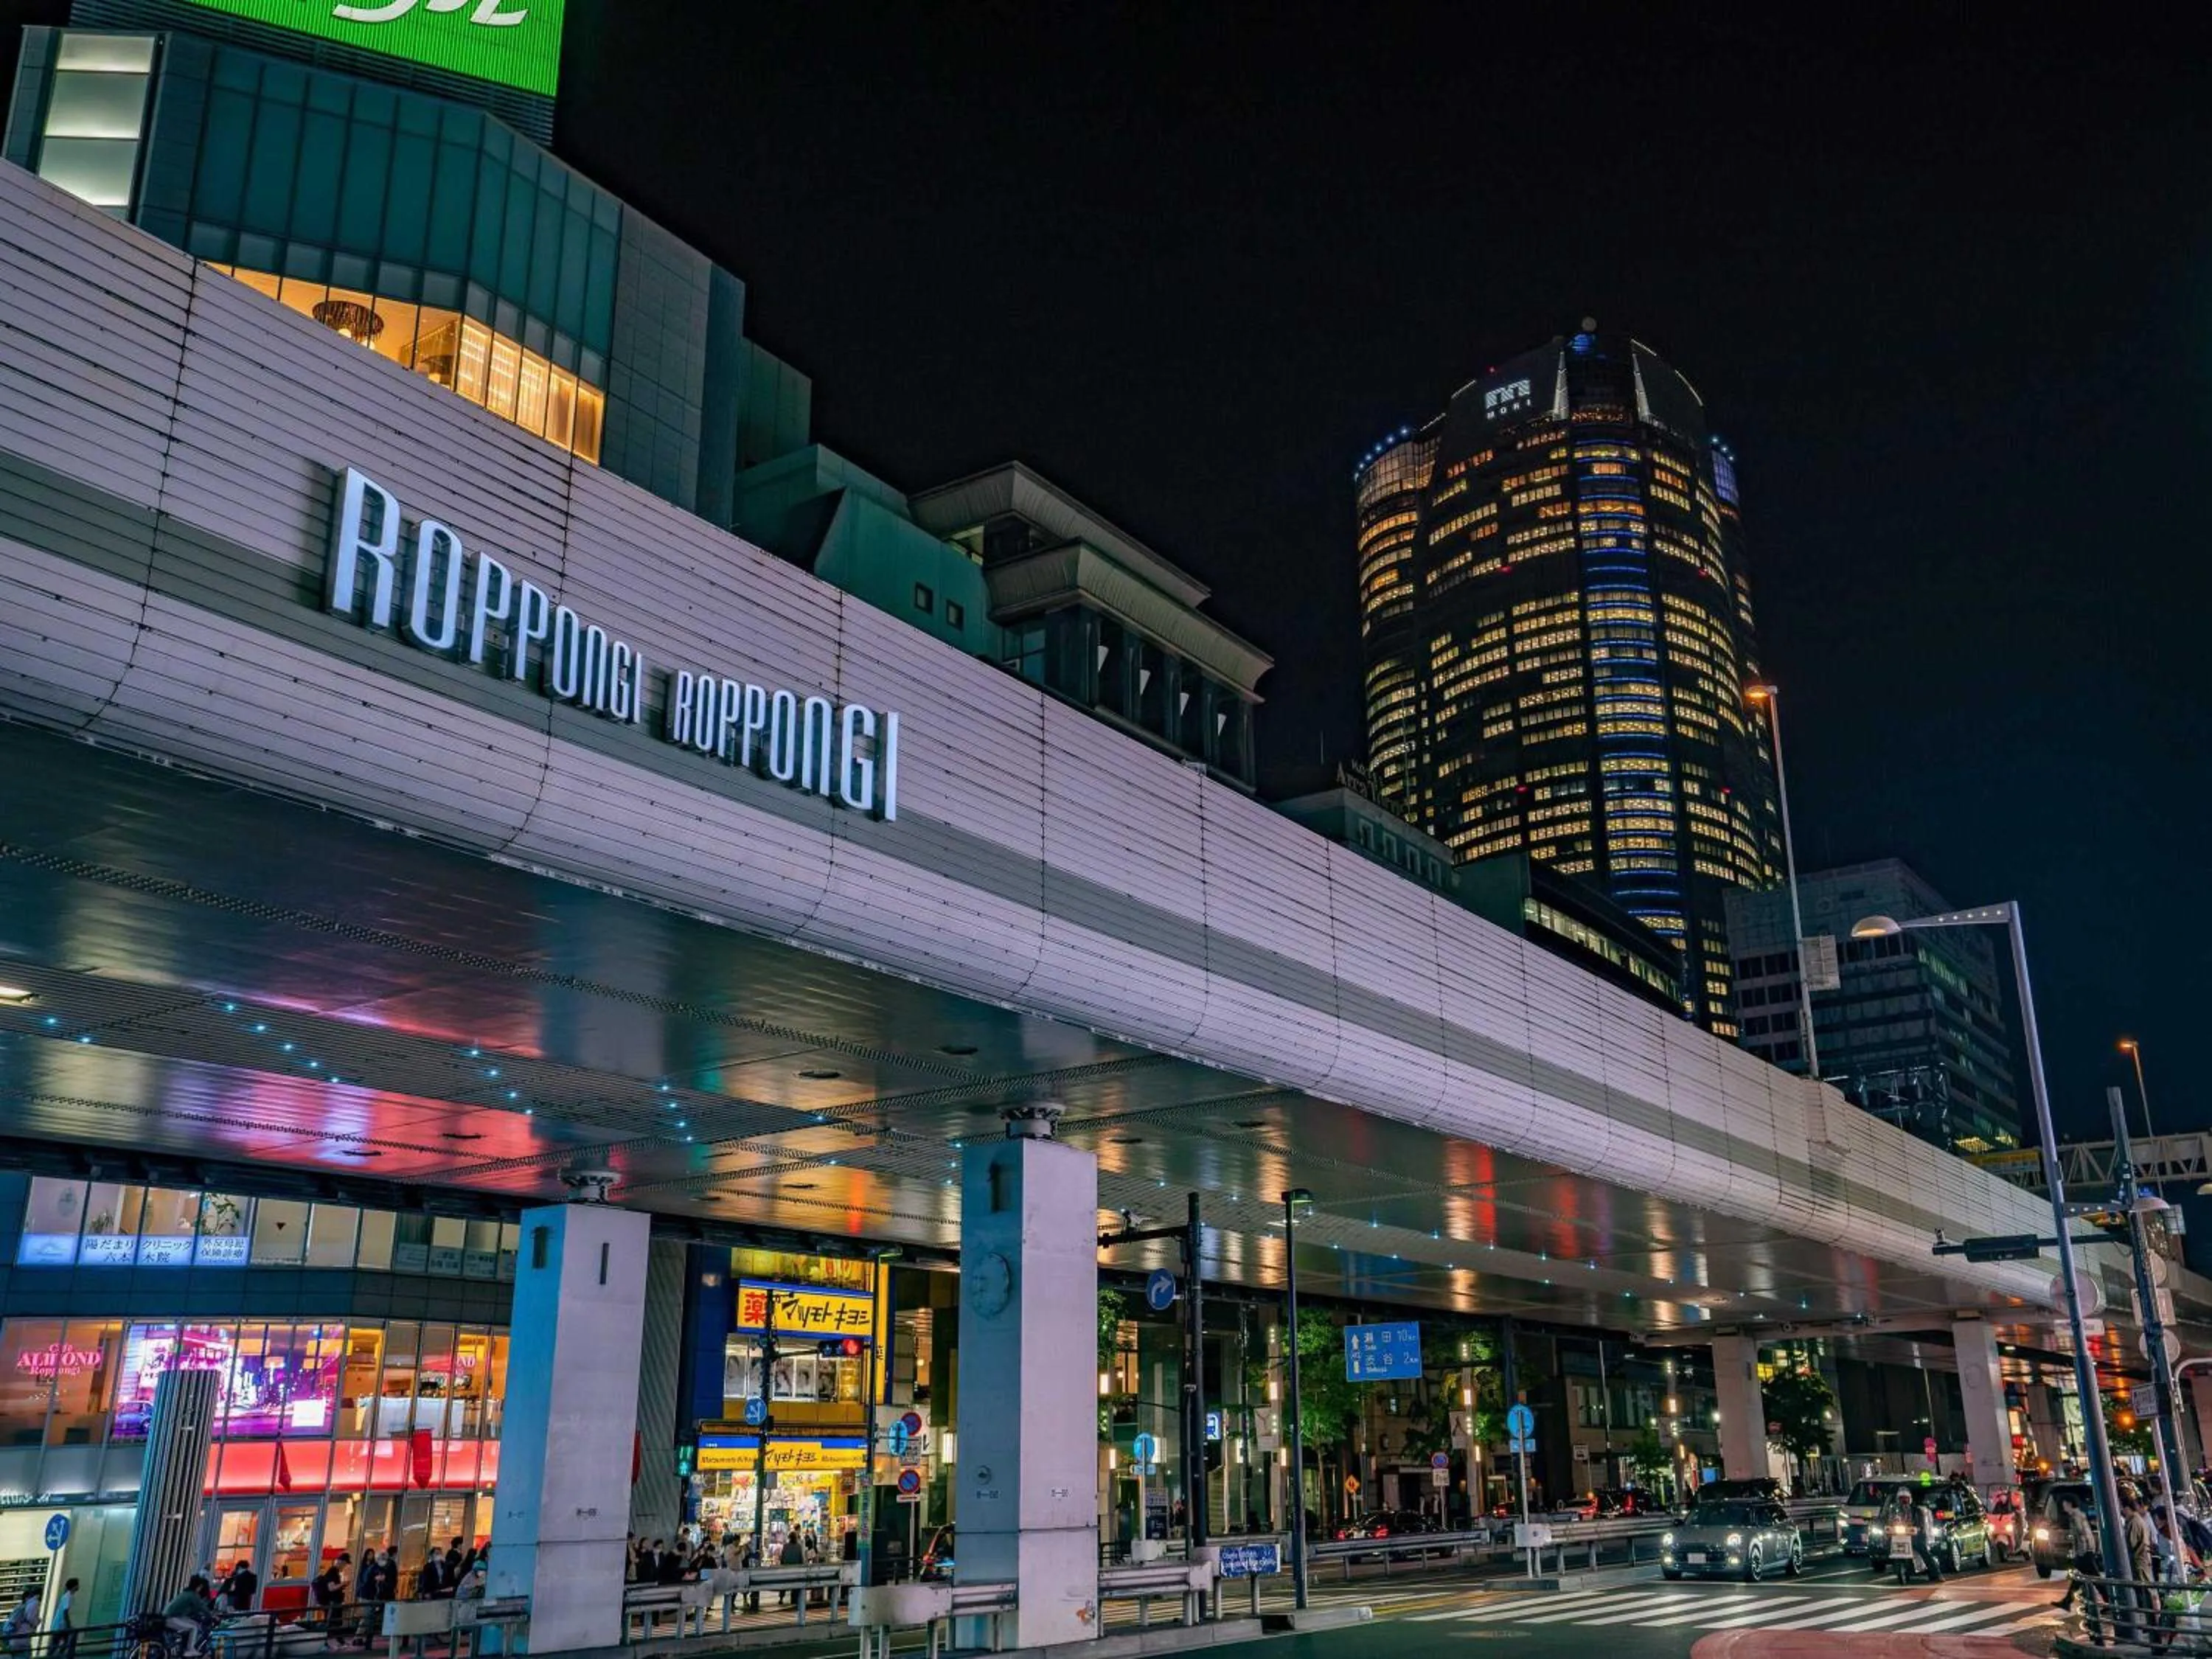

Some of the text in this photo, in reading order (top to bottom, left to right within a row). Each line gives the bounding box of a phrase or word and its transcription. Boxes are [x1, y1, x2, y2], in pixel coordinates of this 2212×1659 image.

[1487, 399, 1531, 419] MORI
[333, 467, 900, 822] ROPPONGI ROPPONGI
[745, 1292, 768, 1324] 薬
[781, 1298, 870, 1330] マツモトキヨシ
